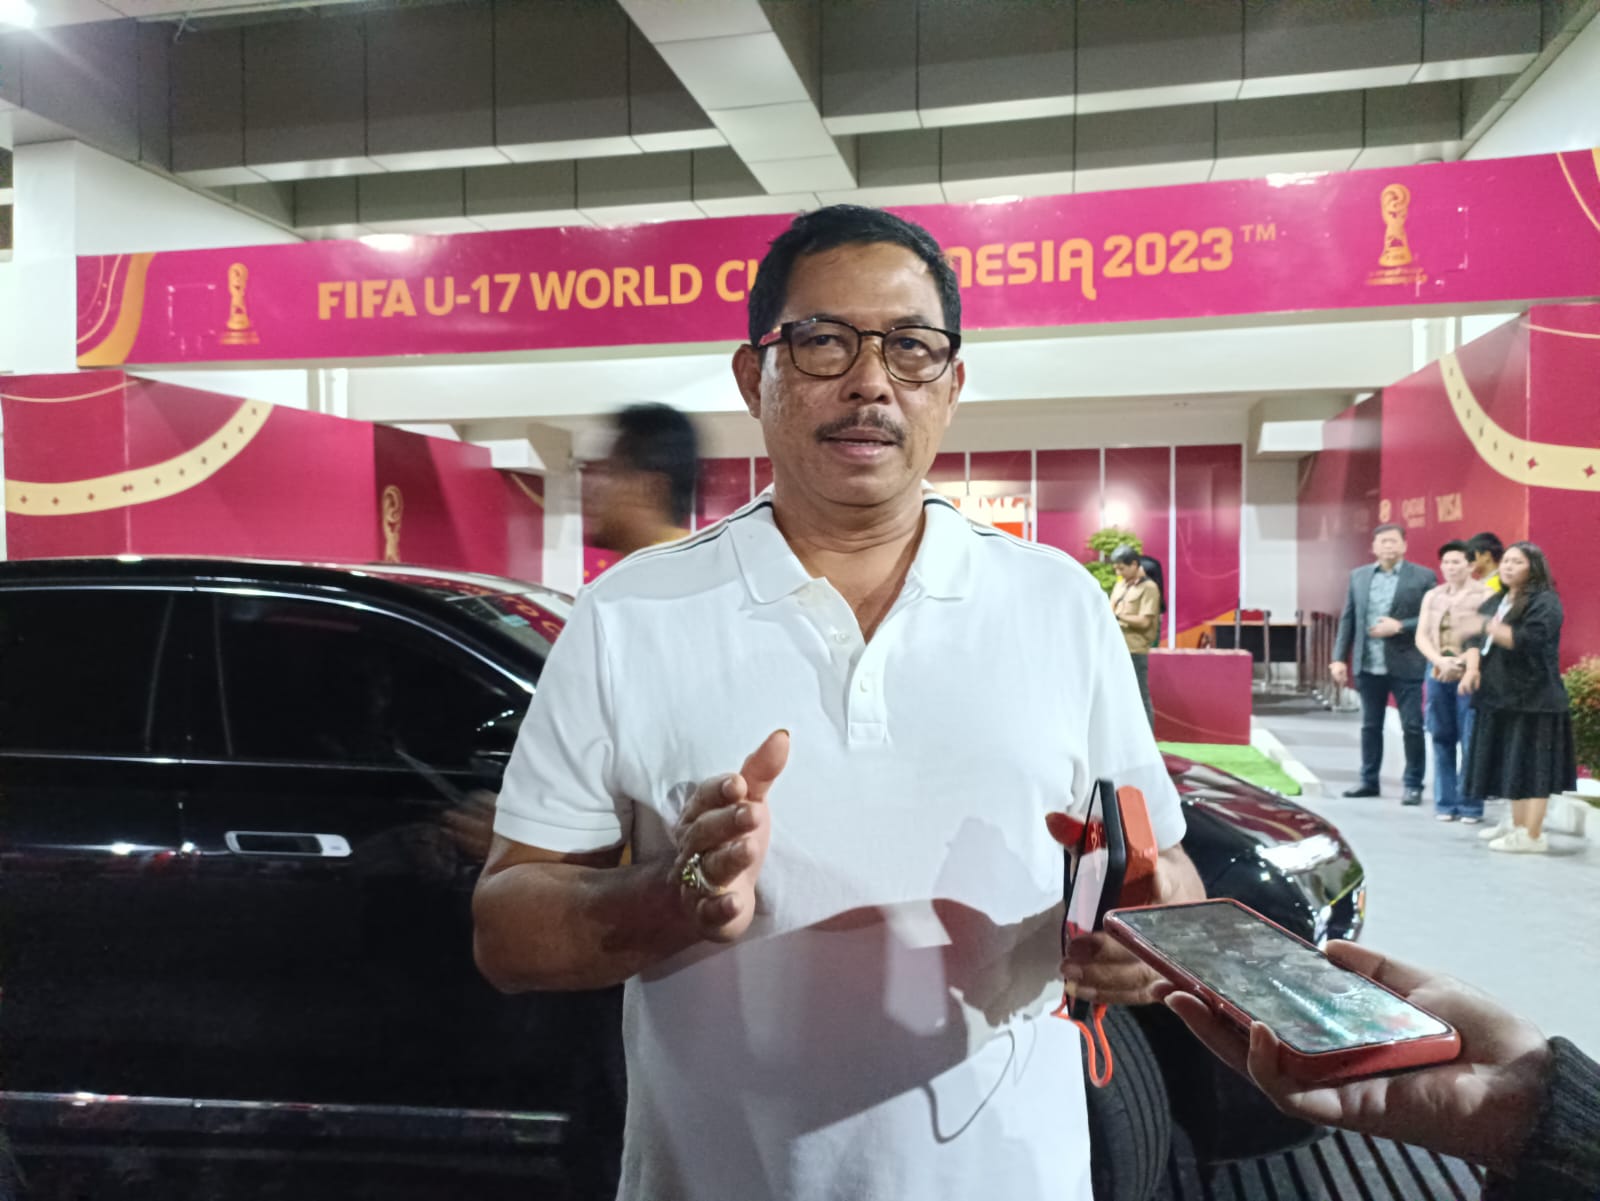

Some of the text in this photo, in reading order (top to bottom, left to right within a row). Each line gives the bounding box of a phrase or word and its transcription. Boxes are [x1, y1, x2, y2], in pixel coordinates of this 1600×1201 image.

[318, 278, 417, 320] FIFA
[424, 273, 521, 316] U-17
[529, 262, 703, 312] WORLD
[944, 237, 1097, 300] NESIA
[1102, 226, 1234, 279] 2023
